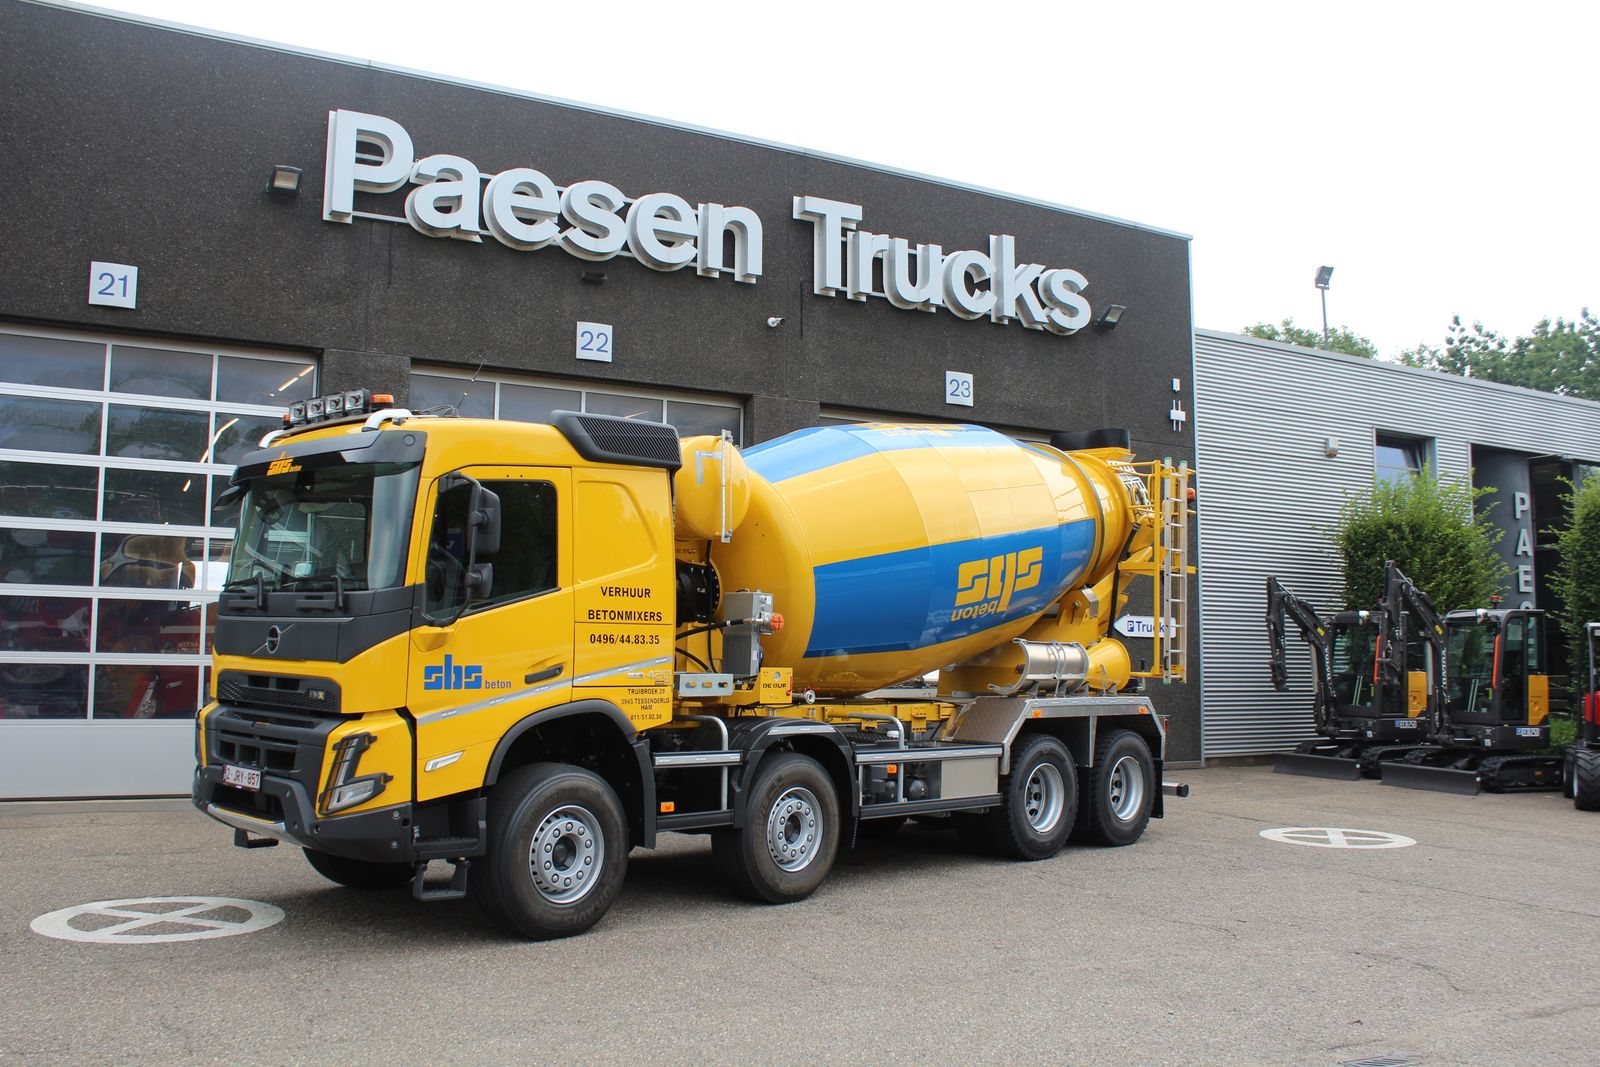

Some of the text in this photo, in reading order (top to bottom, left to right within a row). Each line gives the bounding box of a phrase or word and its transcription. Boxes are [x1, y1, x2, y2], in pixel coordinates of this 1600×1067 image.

[323, 109, 1092, 336] Paesen Trucks
[98, 272, 128, 298] 21
[580, 330, 609, 354] 22
[949, 378, 971, 398] 23
[600, 586, 652, 598] VERHUUR
[588, 609, 663, 622] BETONMIXERS
[950, 600, 999, 621] beton
[1136, 620, 1165, 633] Truk
[589, 633, 661, 645] 0496/44.83.35
[484, 680, 512, 689] beton
